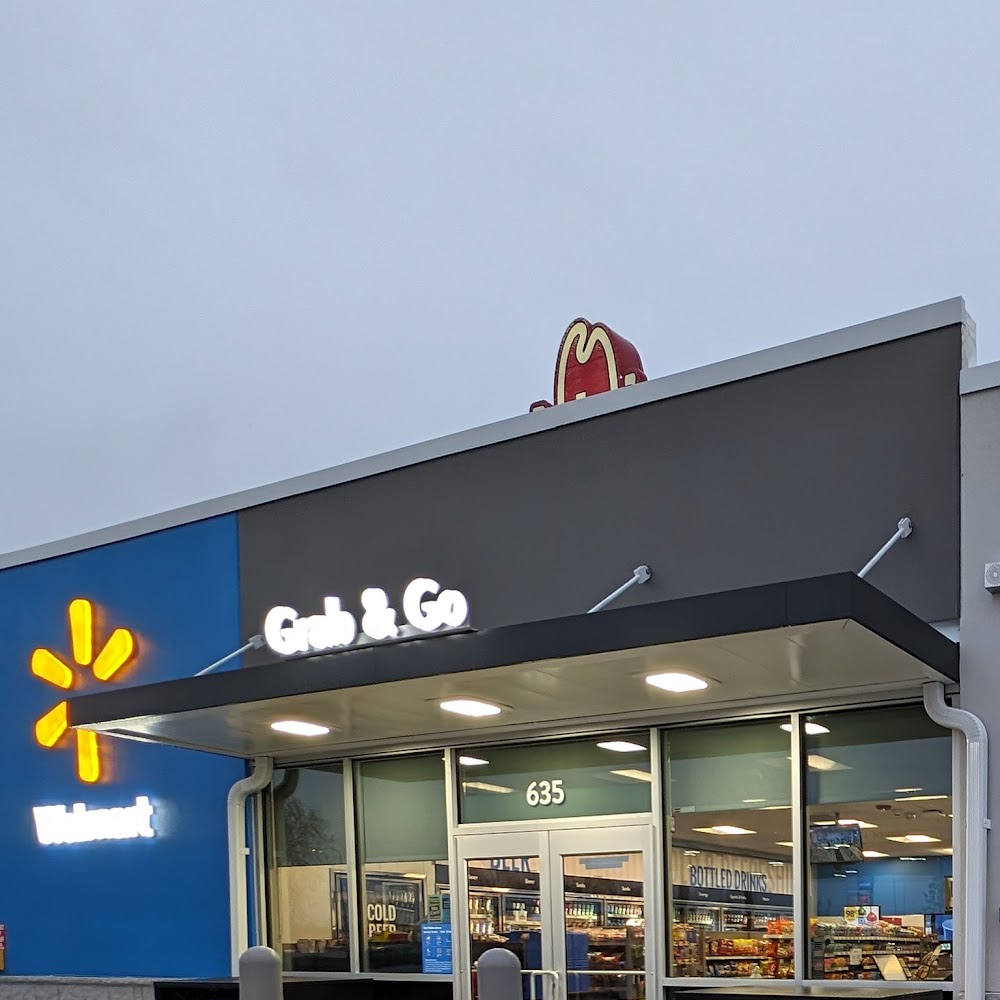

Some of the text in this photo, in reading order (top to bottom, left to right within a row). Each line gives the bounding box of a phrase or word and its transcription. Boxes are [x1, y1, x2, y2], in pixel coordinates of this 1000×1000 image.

[264, 577, 468, 655] Grab & Go
[526, 780, 565, 806] 635
[690, 865, 767, 892] BOTTLED DRINKS
[367, 903, 397, 921] COLD
